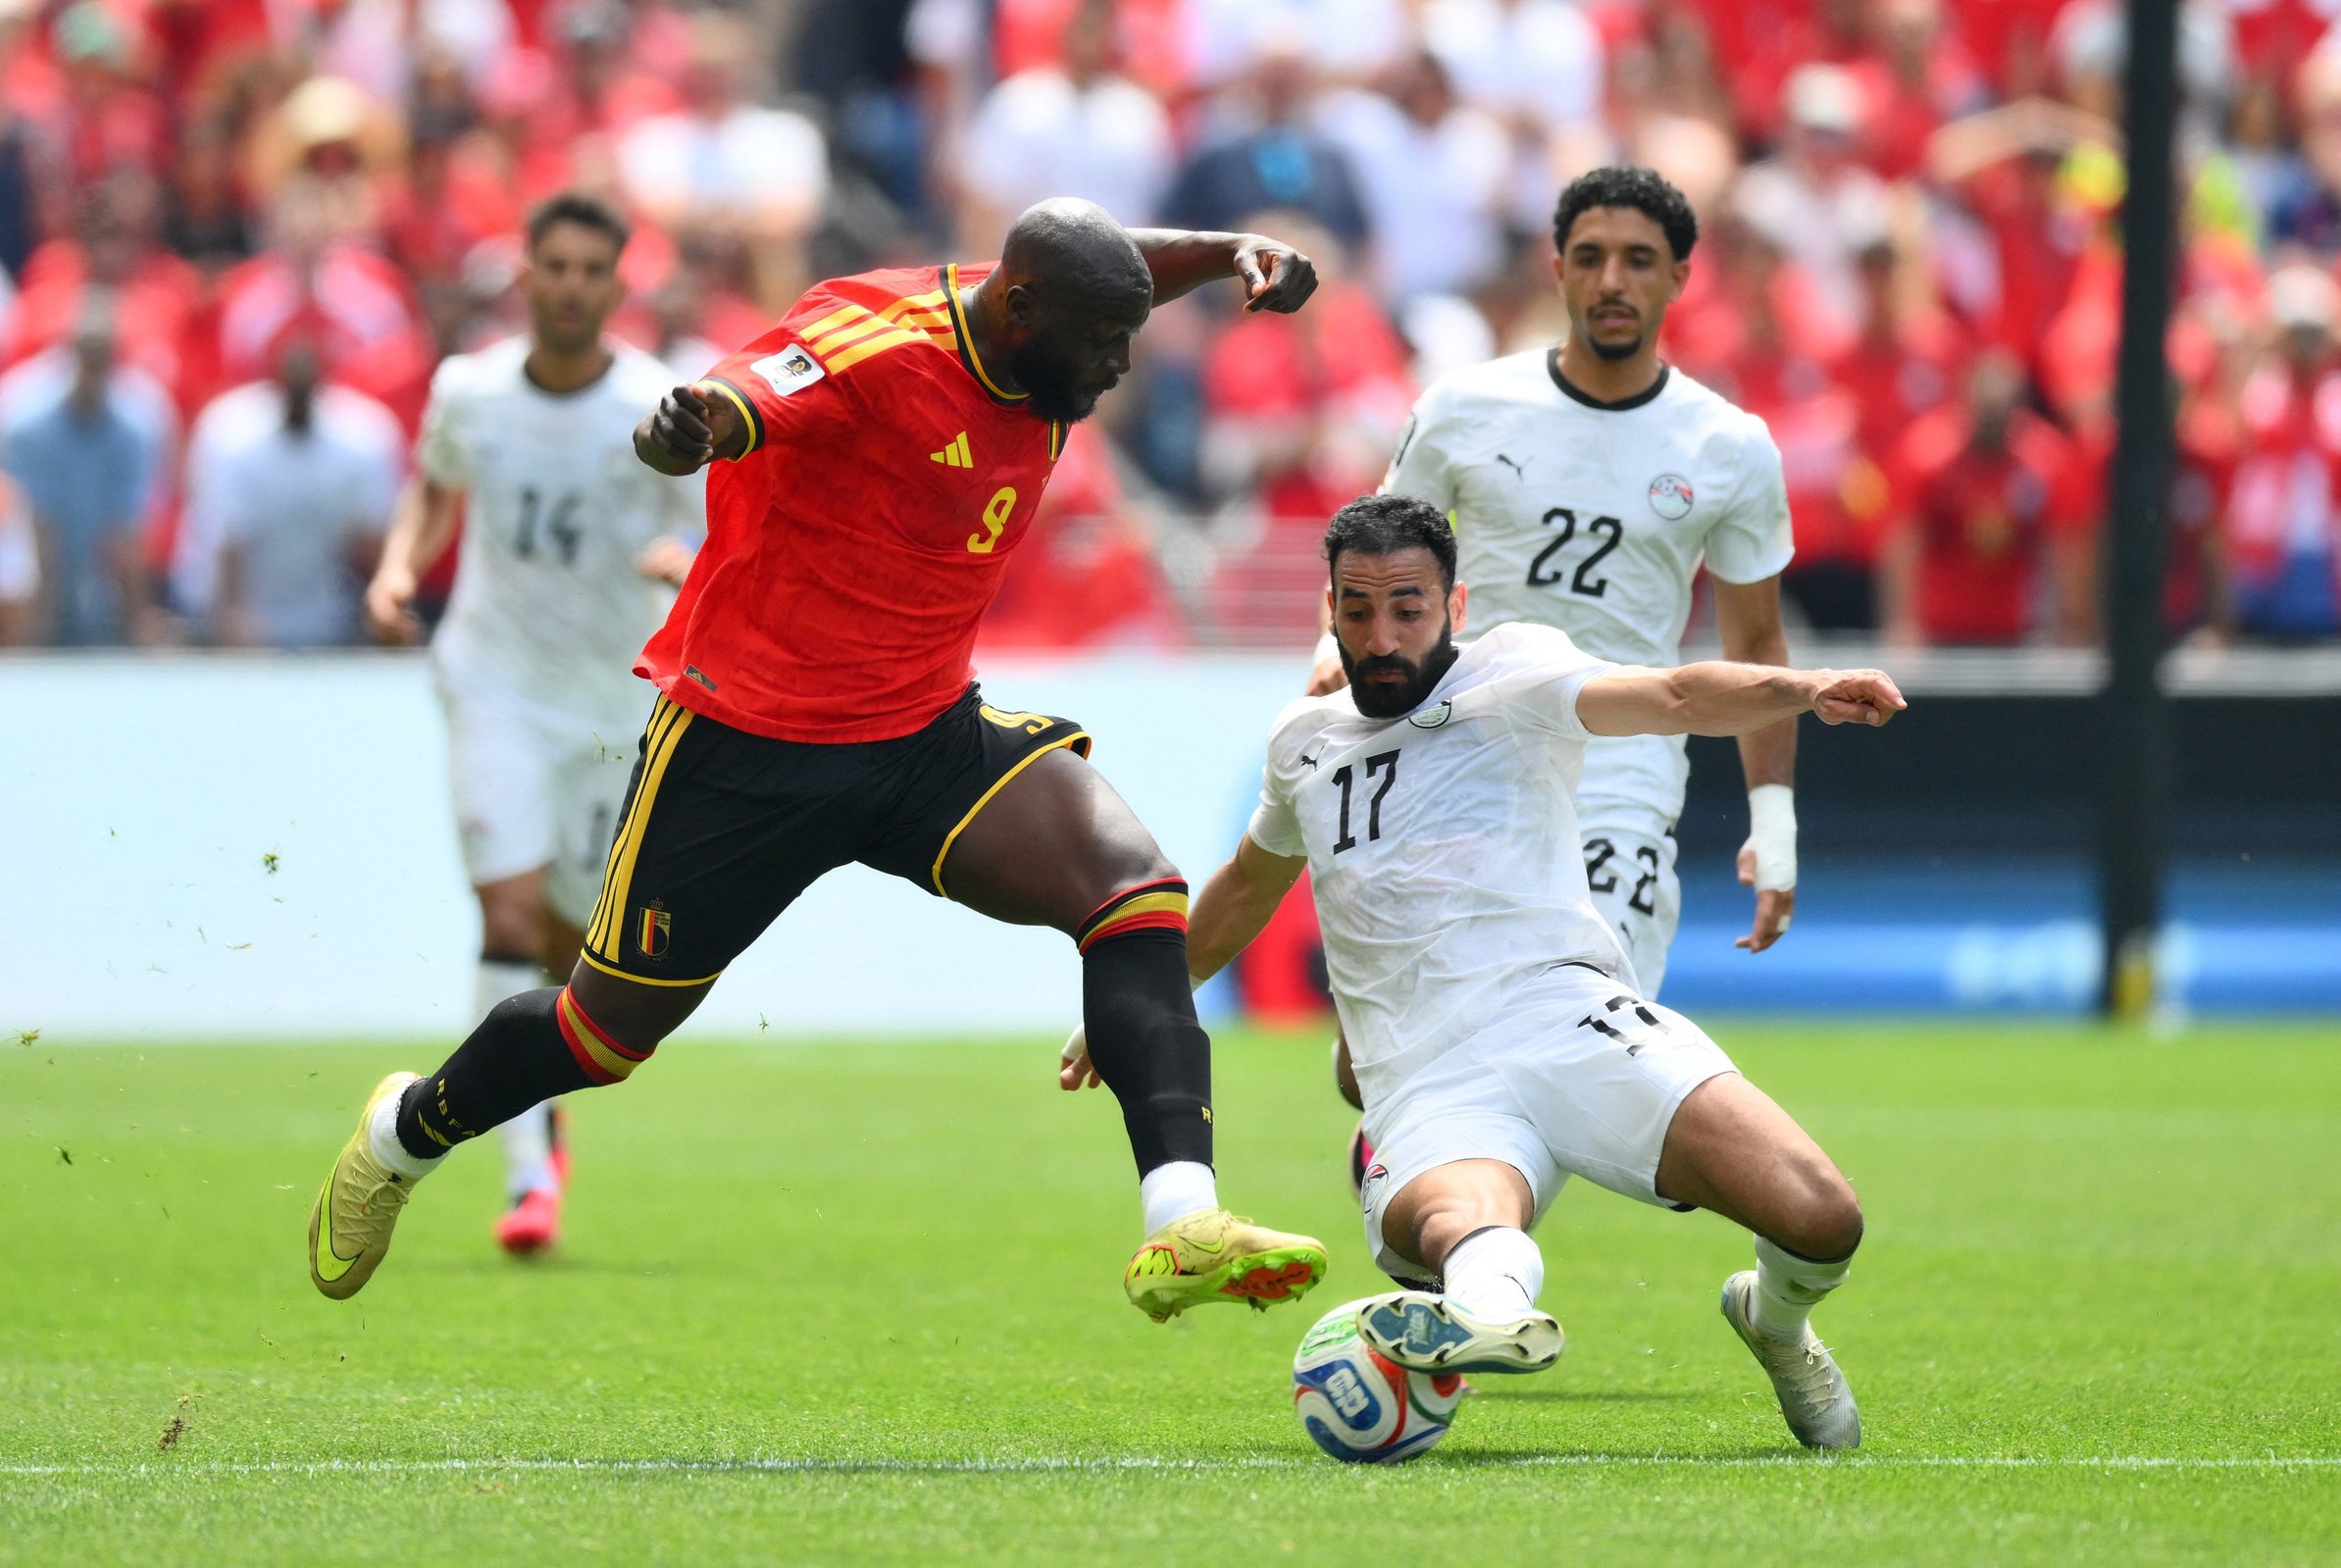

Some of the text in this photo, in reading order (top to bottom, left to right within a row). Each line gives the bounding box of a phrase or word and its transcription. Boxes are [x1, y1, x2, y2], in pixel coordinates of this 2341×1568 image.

[513, 487, 583, 565] 14
[967, 486, 1017, 553] 9
[1527, 508, 1622, 597] 22
[979, 705, 1054, 734] 9
[1332, 748, 1401, 855] 17
[1583, 838, 1657, 917] 22
[1577, 994, 1671, 1057] 17
